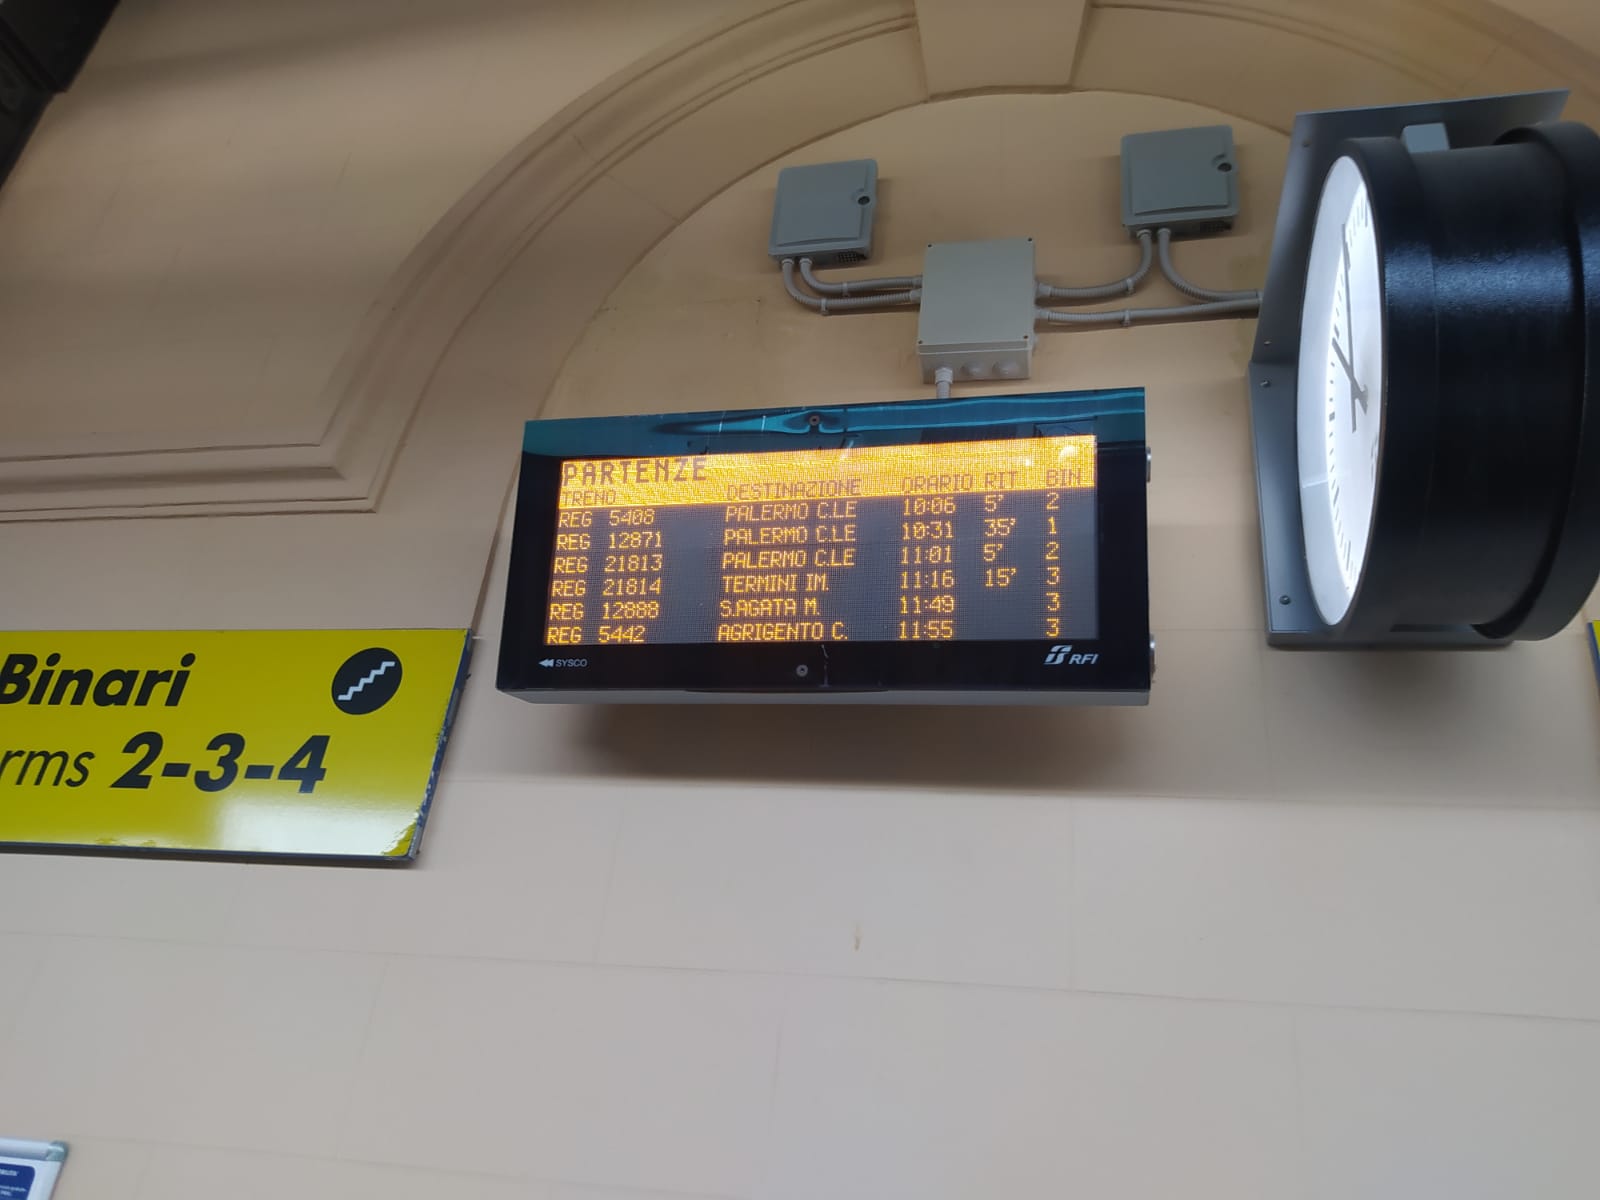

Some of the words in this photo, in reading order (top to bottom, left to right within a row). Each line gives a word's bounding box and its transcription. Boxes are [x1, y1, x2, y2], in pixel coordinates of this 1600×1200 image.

[560, 490, 617, 506] TRENO
[726, 478, 862, 500] DESTINAZIONE
[902, 473, 973, 492] ORARIO
[984, 471, 1018, 489] RIT
[1045, 468, 1081, 487] BIN
[564, 457, 707, 486] PARTENZE
[558, 511, 593, 528] REG
[608, 508, 656, 526] 5408
[725, 502, 809, 522] PALERMO
[816, 500, 858, 519] C.LE
[902, 496, 957, 516] 10:06
[1046, 492, 1060, 510] 2
[555, 533, 591, 550] REG
[608, 531, 662, 549] 12871
[724, 526, 808, 546] PALERMO
[816, 523, 856, 542] C.LE
[902, 520, 954, 540] 10:31
[1048, 515, 1058, 535] 1
[553, 556, 588, 574] REG
[604, 554, 663, 572] 21813
[722, 550, 807, 569] PALERMO
[814, 548, 855, 567] C.LE
[901, 545, 952, 564] 11:01
[1045, 541, 1060, 560] 2
[551, 579, 586, 597] REG
[602, 577, 662, 596] 21814
[722, 574, 798, 593] TERMINI
[805, 573, 830, 592] IM.
[900, 569, 955, 589] 11:16
[1046, 566, 1060, 585] 3
[549, 602, 584, 621] REG
[602, 600, 660, 620] 12888
[719, 598, 797, 617] S.AGATA
[804, 597, 820, 616] M.
[900, 594, 955, 614] 11:49
[1046, 592, 1060, 611] 3
[547, 626, 582, 644] REG
[598, 625, 646, 643] 5442
[718, 622, 824, 642] AGRIGENTO
[832, 621, 848, 640] C.
[899, 619, 955, 639] 11:55
[1046, 617, 1060, 637] 3
[555, 658, 588, 668] SYSCO
[1068, 653, 1099, 665] RFI
[0, 652, 196, 707] Binari
[110, 731, 331, 793] 2-3-4
